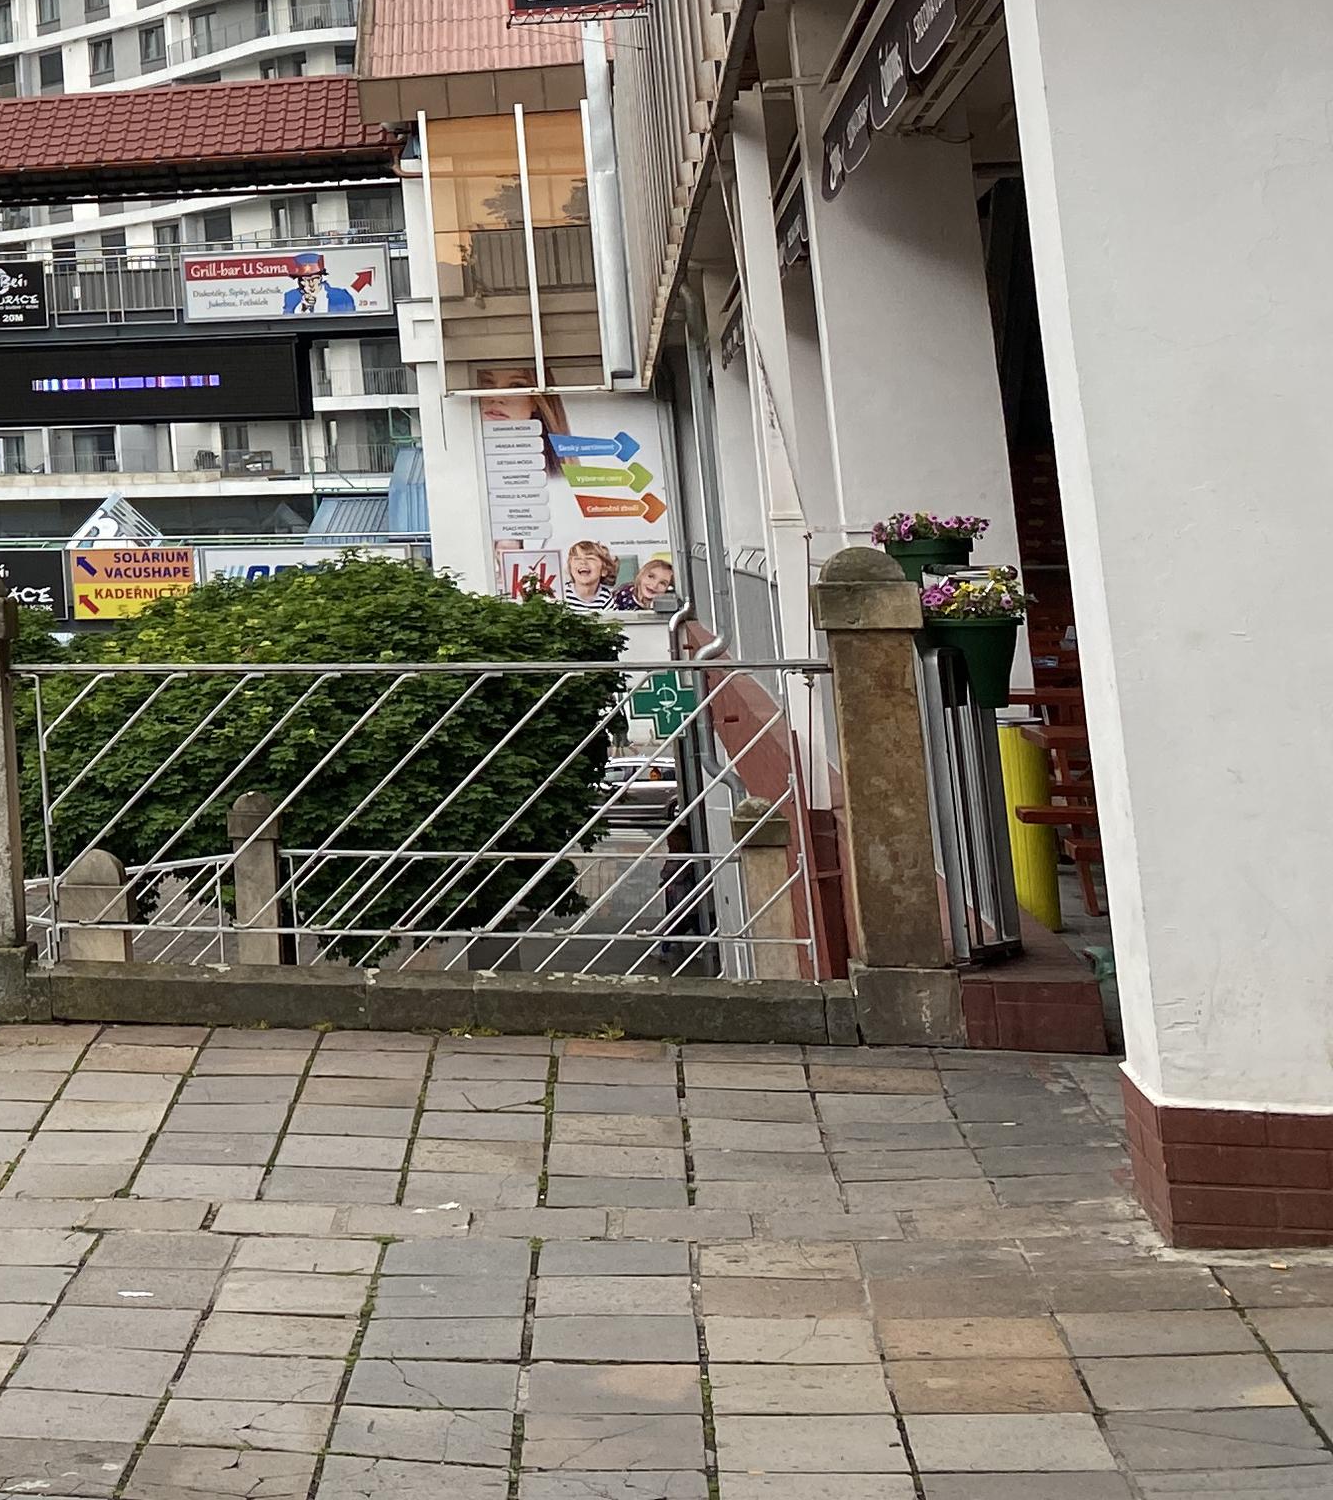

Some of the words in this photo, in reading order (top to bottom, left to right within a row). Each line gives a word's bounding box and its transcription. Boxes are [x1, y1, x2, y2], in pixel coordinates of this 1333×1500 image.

[190, 261, 241, 278] Grill-bar
[242, 262, 254, 276] U
[255, 262, 289, 275] Sama
[2, 313, 24, 323] 20M
[113, 550, 189, 563] SOLÁRIUM
[104, 566, 191, 578] VACUSHAPE
